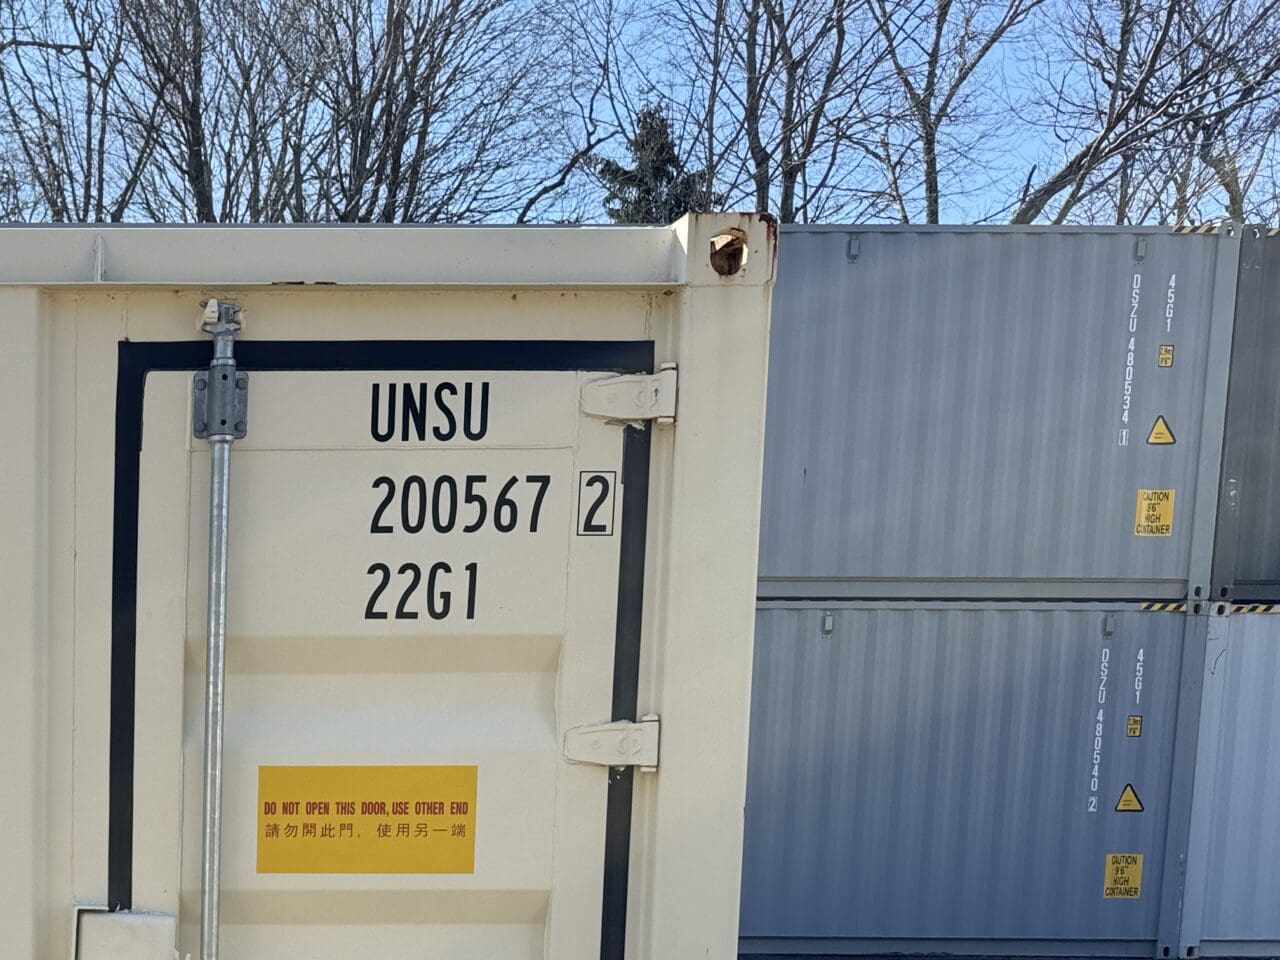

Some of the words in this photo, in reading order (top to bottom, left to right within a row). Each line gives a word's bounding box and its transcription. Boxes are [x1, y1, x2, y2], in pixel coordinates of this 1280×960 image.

[1129, 274, 1141, 332] DSZU
[1165, 274, 1176, 332] 45G1
[1122, 337, 1135, 424] 480534
[370, 381, 490, 442] UNSU
[370, 474, 551, 534] 200567
[583, 474, 610, 532] 2
[364, 561, 477, 620] 22G1
[1098, 649, 1109, 703] DSZU
[1134, 649, 1144, 703] 45G1
[1091, 709, 1103, 791] 480540
[264, 801, 276, 815] DO
[282, 801, 300, 815] NOT
[306, 801, 329, 815] OPEN
[336, 801, 355, 815] THIS
[392, 801, 409, 815] USE
[415, 801, 444, 815] OTHER
[450, 801, 468, 815] END
